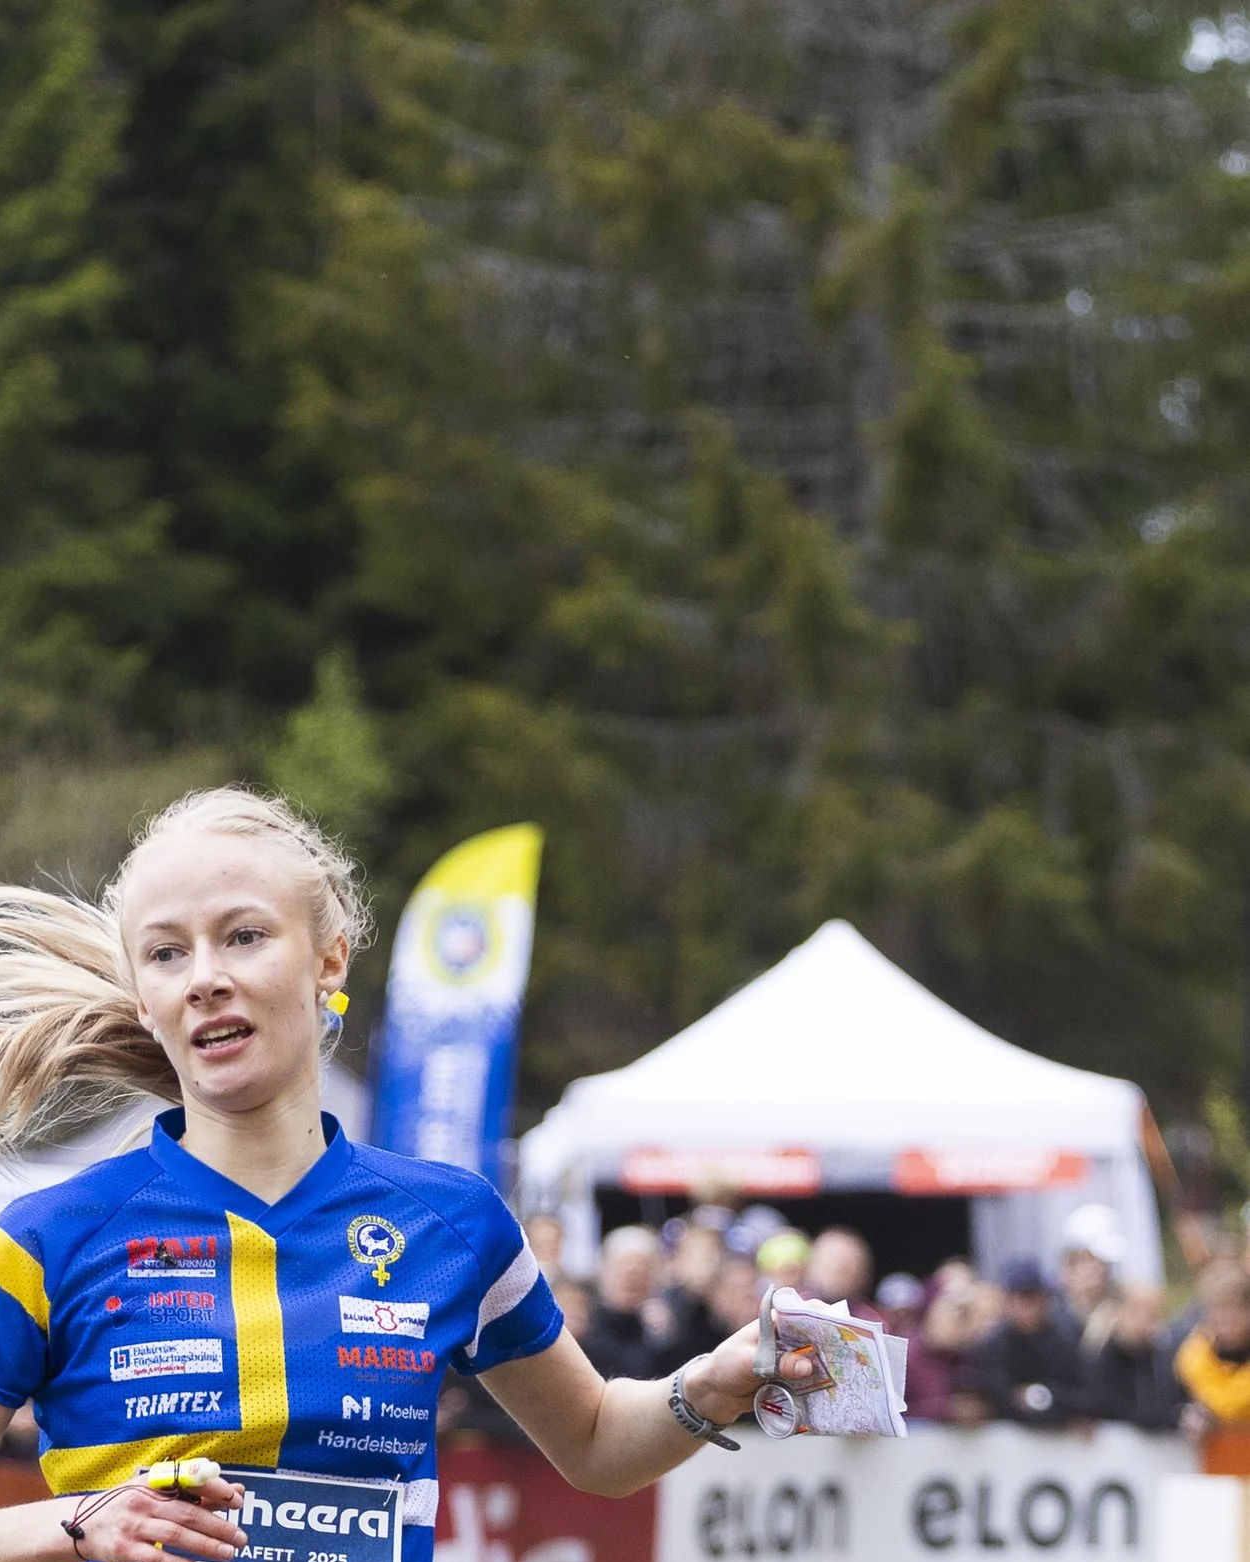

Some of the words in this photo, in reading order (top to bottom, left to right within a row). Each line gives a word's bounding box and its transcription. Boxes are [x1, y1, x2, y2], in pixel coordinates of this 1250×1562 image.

[149, 1291, 214, 1308] INTER
[150, 1307, 215, 1324] SPORT
[337, 1345, 435, 1373] MARELD
[125, 1391, 223, 1419] TRIMTEX
[381, 1402, 429, 1420] Moelven
